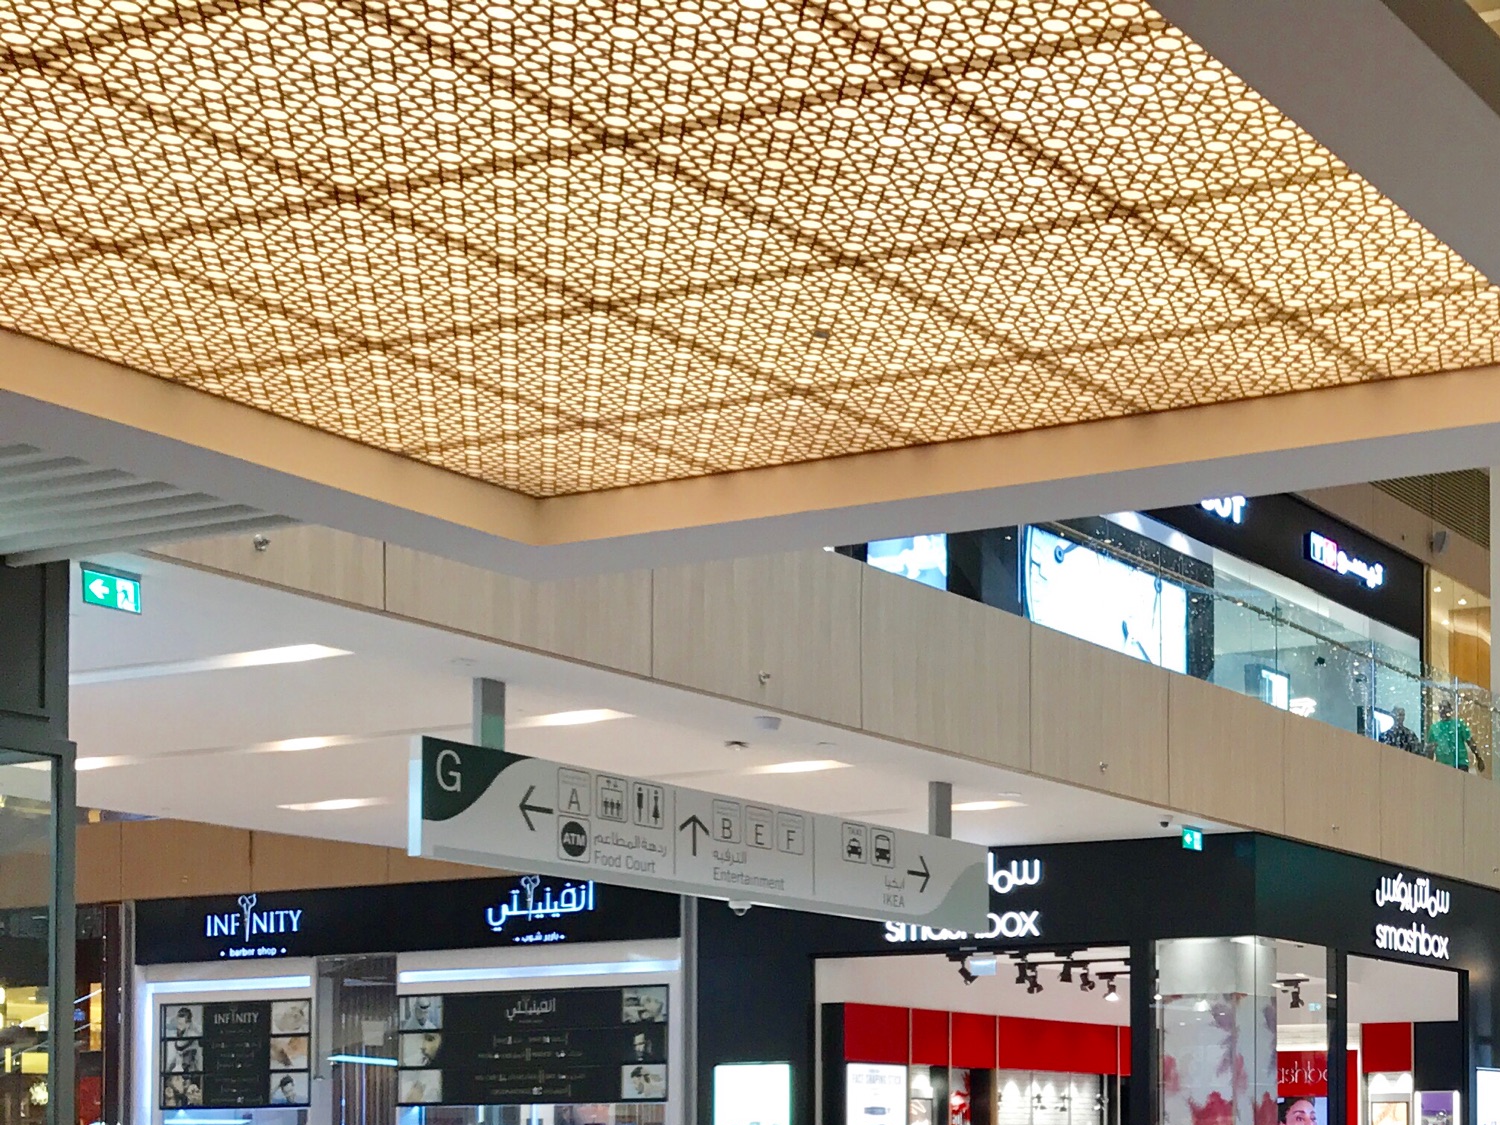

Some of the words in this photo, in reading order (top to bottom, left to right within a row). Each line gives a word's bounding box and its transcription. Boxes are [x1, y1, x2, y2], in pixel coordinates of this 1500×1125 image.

[436, 749, 462, 793] G
[568, 787, 581, 812] A
[562, 832, 588, 848] ATM
[721, 817, 733, 839] B
[754, 823, 765, 847] E
[786, 829, 797, 851] F
[594, 849, 622, 869] Food
[625, 855, 656, 874] Court
[712, 866, 785, 892] Entertainment
[882, 893, 906, 909] IKEA
[257, 946, 277, 957] shop
[1375, 921, 1450, 960] smashbox
